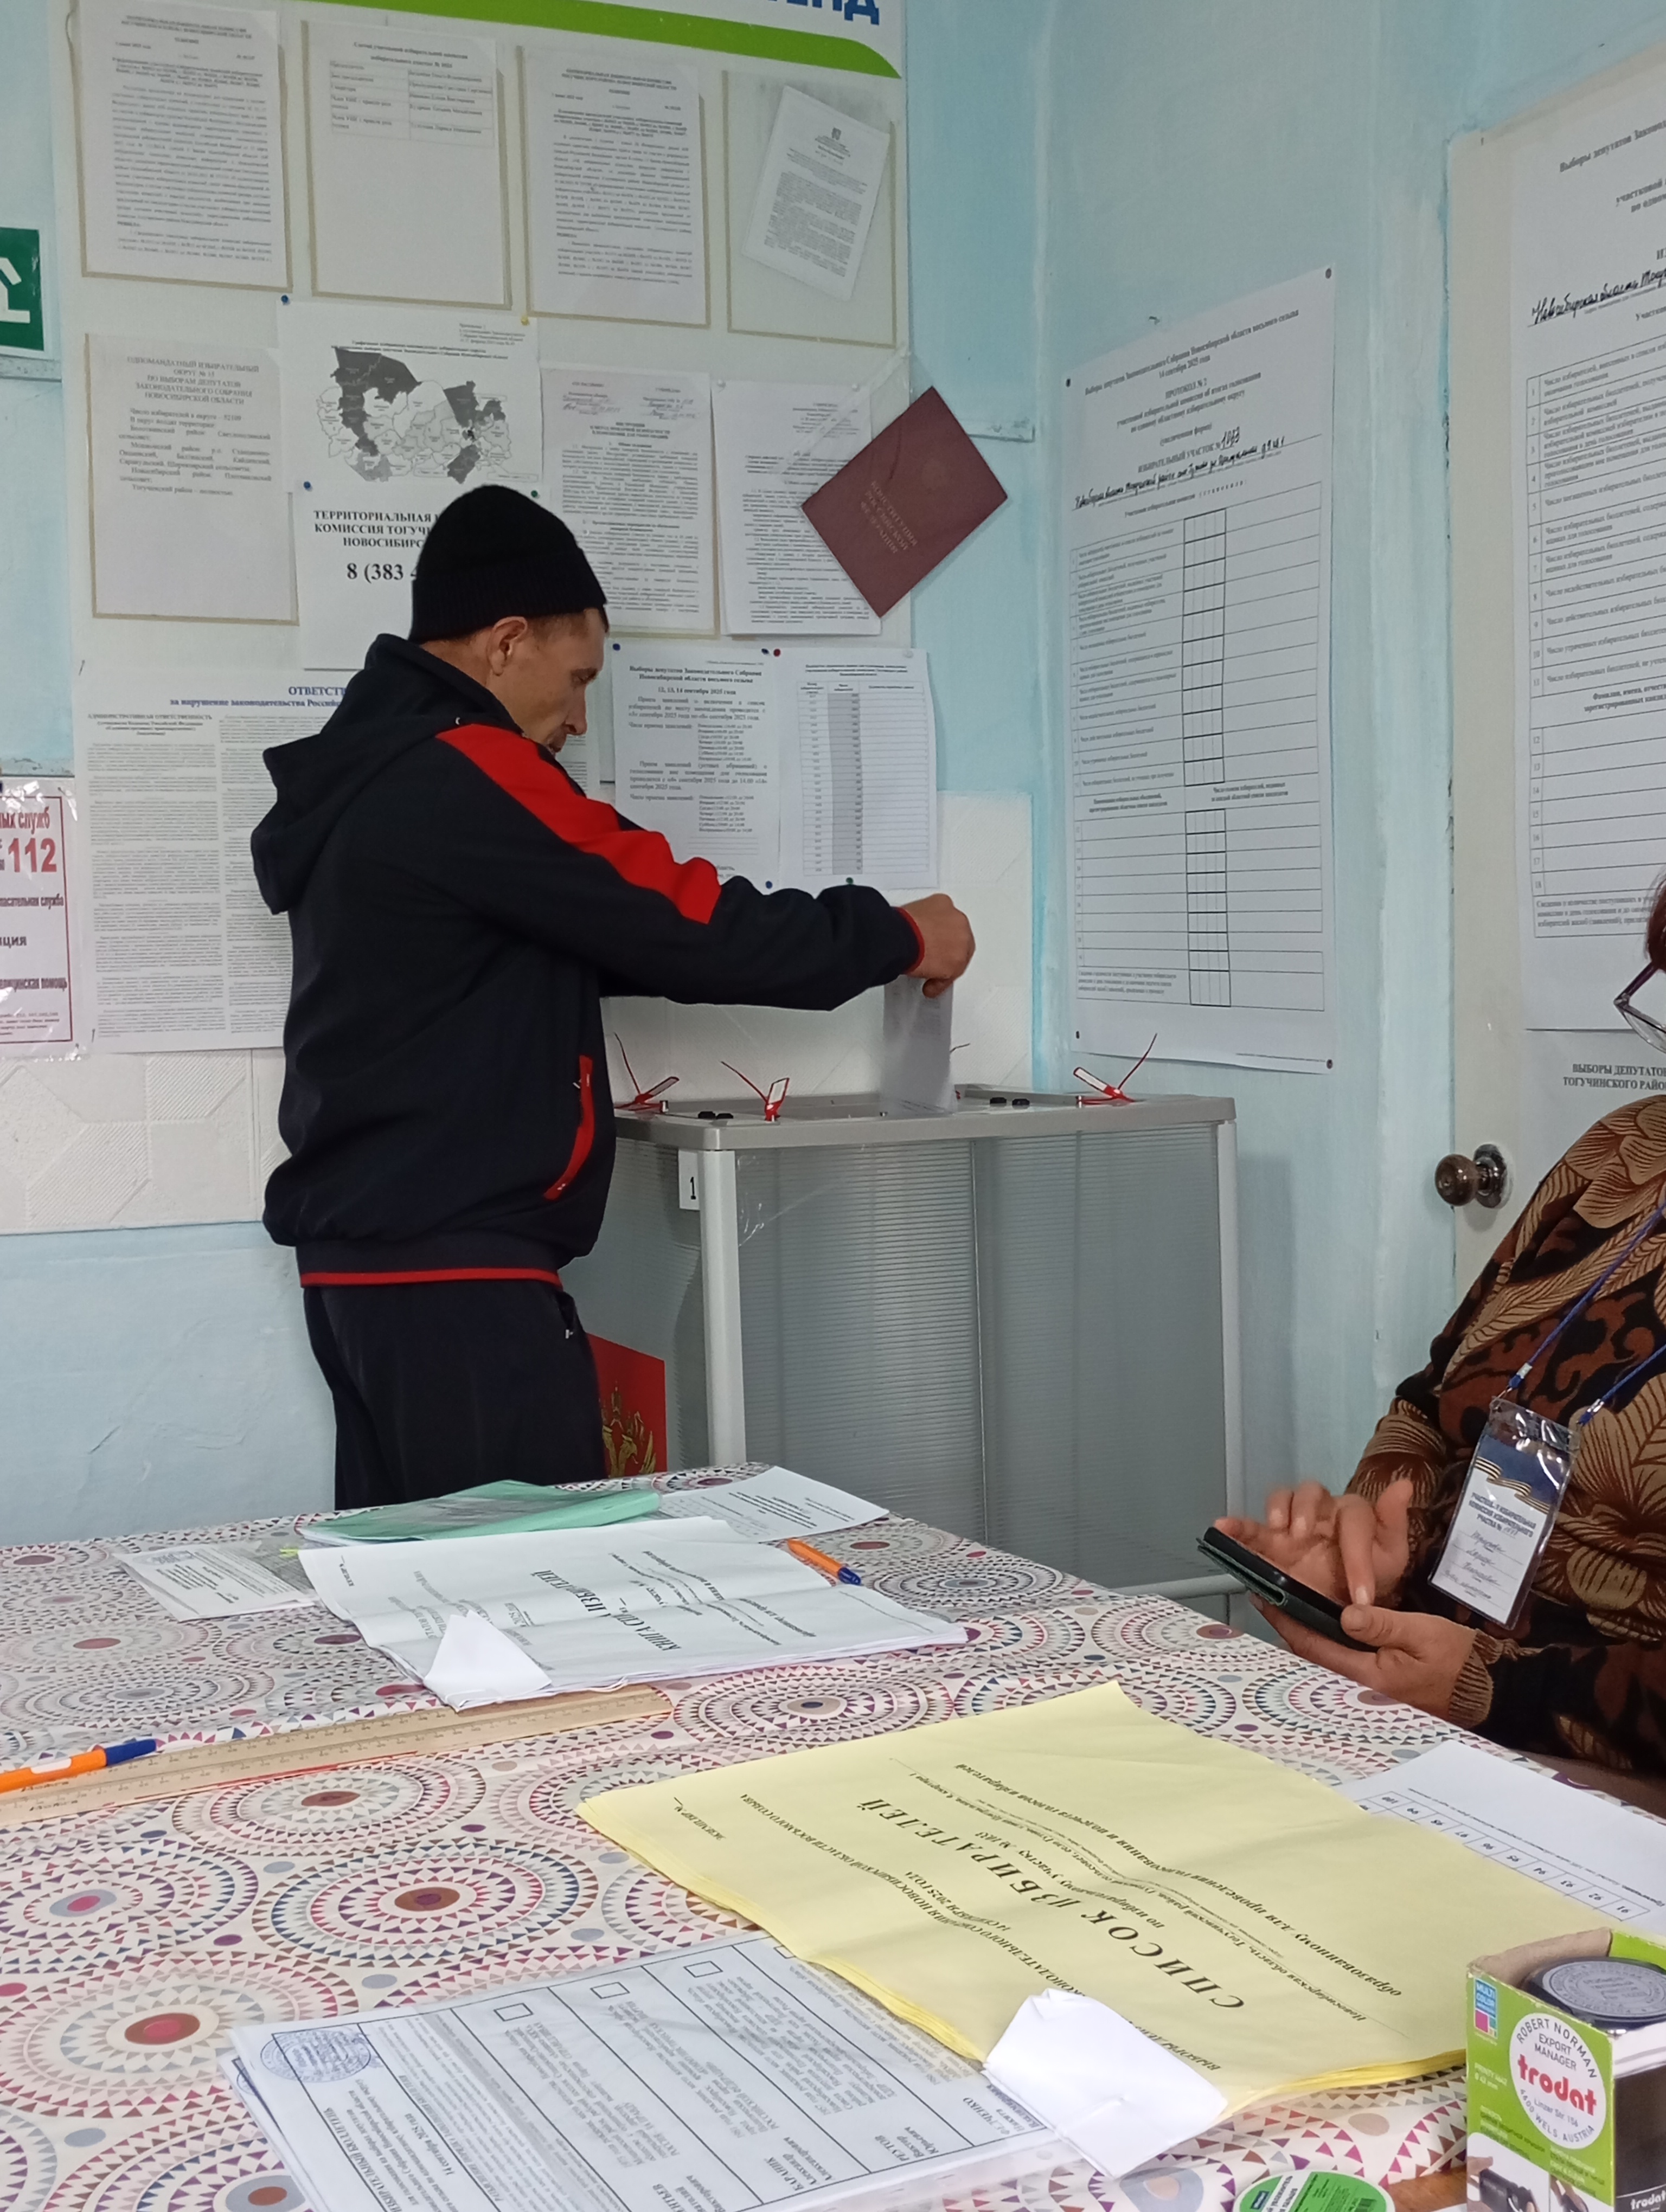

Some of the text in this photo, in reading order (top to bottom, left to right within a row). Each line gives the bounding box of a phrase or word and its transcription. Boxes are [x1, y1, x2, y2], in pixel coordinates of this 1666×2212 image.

[313, 510, 432, 522] ТЕРРИТОРИАЛЬНАЯ
[314, 524, 384, 534] КОМИССИЯ
[347, 563, 358, 580] 8
[18, 806, 50, 835] служб
[8, 838, 57, 873] 112
[1572, 1064, 1612, 1074] ВЫБОРЫ
[1563, 1077, 1666, 1091] ТОГУЧИНСКОГО РАЙО
[690, 1176, 696, 1200] 1
[636, 1626, 682, 1651] КНИГА
[954, 1763, 1017, 1796] избирателей
[740, 1793, 773, 1817] СОЗЫВА
[1406, 1807, 1419, 1815] 99
[770, 1815, 816, 1846] ВОСЬМОГО
[1058, 1812, 1108, 1837] подсчета
[813, 1841, 854, 1865] ОБЛАСТИ
[1116, 1838, 1191, 1878] голосования
[1482, 1842, 1494, 1850] 96
[1506, 1854, 1520, 1862] 95
[1017, 1849, 1064, 1879] участку
[851, 1860, 933, 1914] НОВОСИБИРСКОЙ
[904, 1871, 933, 1895] ГОДА
[1191, 1874, 1266, 1914] проведения
[1560, 1879, 1574, 1888] 93
[1588, 1892, 1602, 1901] 92
[856, 1798, 1244, 2008] СПИСОК ИЗБИРАТЕЛЕЙ
[927, 1889, 952, 1905] 2025
[1616, 1905, 1629, 1913] 91
[1146, 1917, 1165, 1928] по
[1183, 1909, 1245, 1947] Тогучинский
[1265, 1914, 1296, 1933] для
[1249, 1946, 1288, 1975] область,
[1295, 1933, 1402, 1996] образованному
[1286, 1972, 1367, 2022] Новосибирская
[1160, 2042, 1221, 2070] ВЫБОРЫ
[1516, 2018, 1597, 2078] ROBERT NORMAN
[1534, 2043, 1577, 2071] MANAGER
[1538, 2033, 1573, 2056] EXPORT
[1517, 2053, 1597, 2116] trodat
[1520, 2089, 1595, 2143] 4600 AUSTRIA
[1534, 2097, 1554, 2113] Linzer
[1567, 2116, 1579, 2127] 156
[323, 2107, 359, 2152] БЮЛЛЕТЕНЬ
[905, 2126, 939, 2155] Юрьевич
[783, 2137, 834, 2181] Александрович
[874, 2134, 910, 2161] РЕУТОВ
[897, 2136, 925, 2158] Виктор
[442, 2167, 455, 2176] 14
[764, 2157, 804, 2191] БАРАНИК
[783, 2154, 817, 2185] Александр
[1630, 2190, 1666, 2210] trodat
